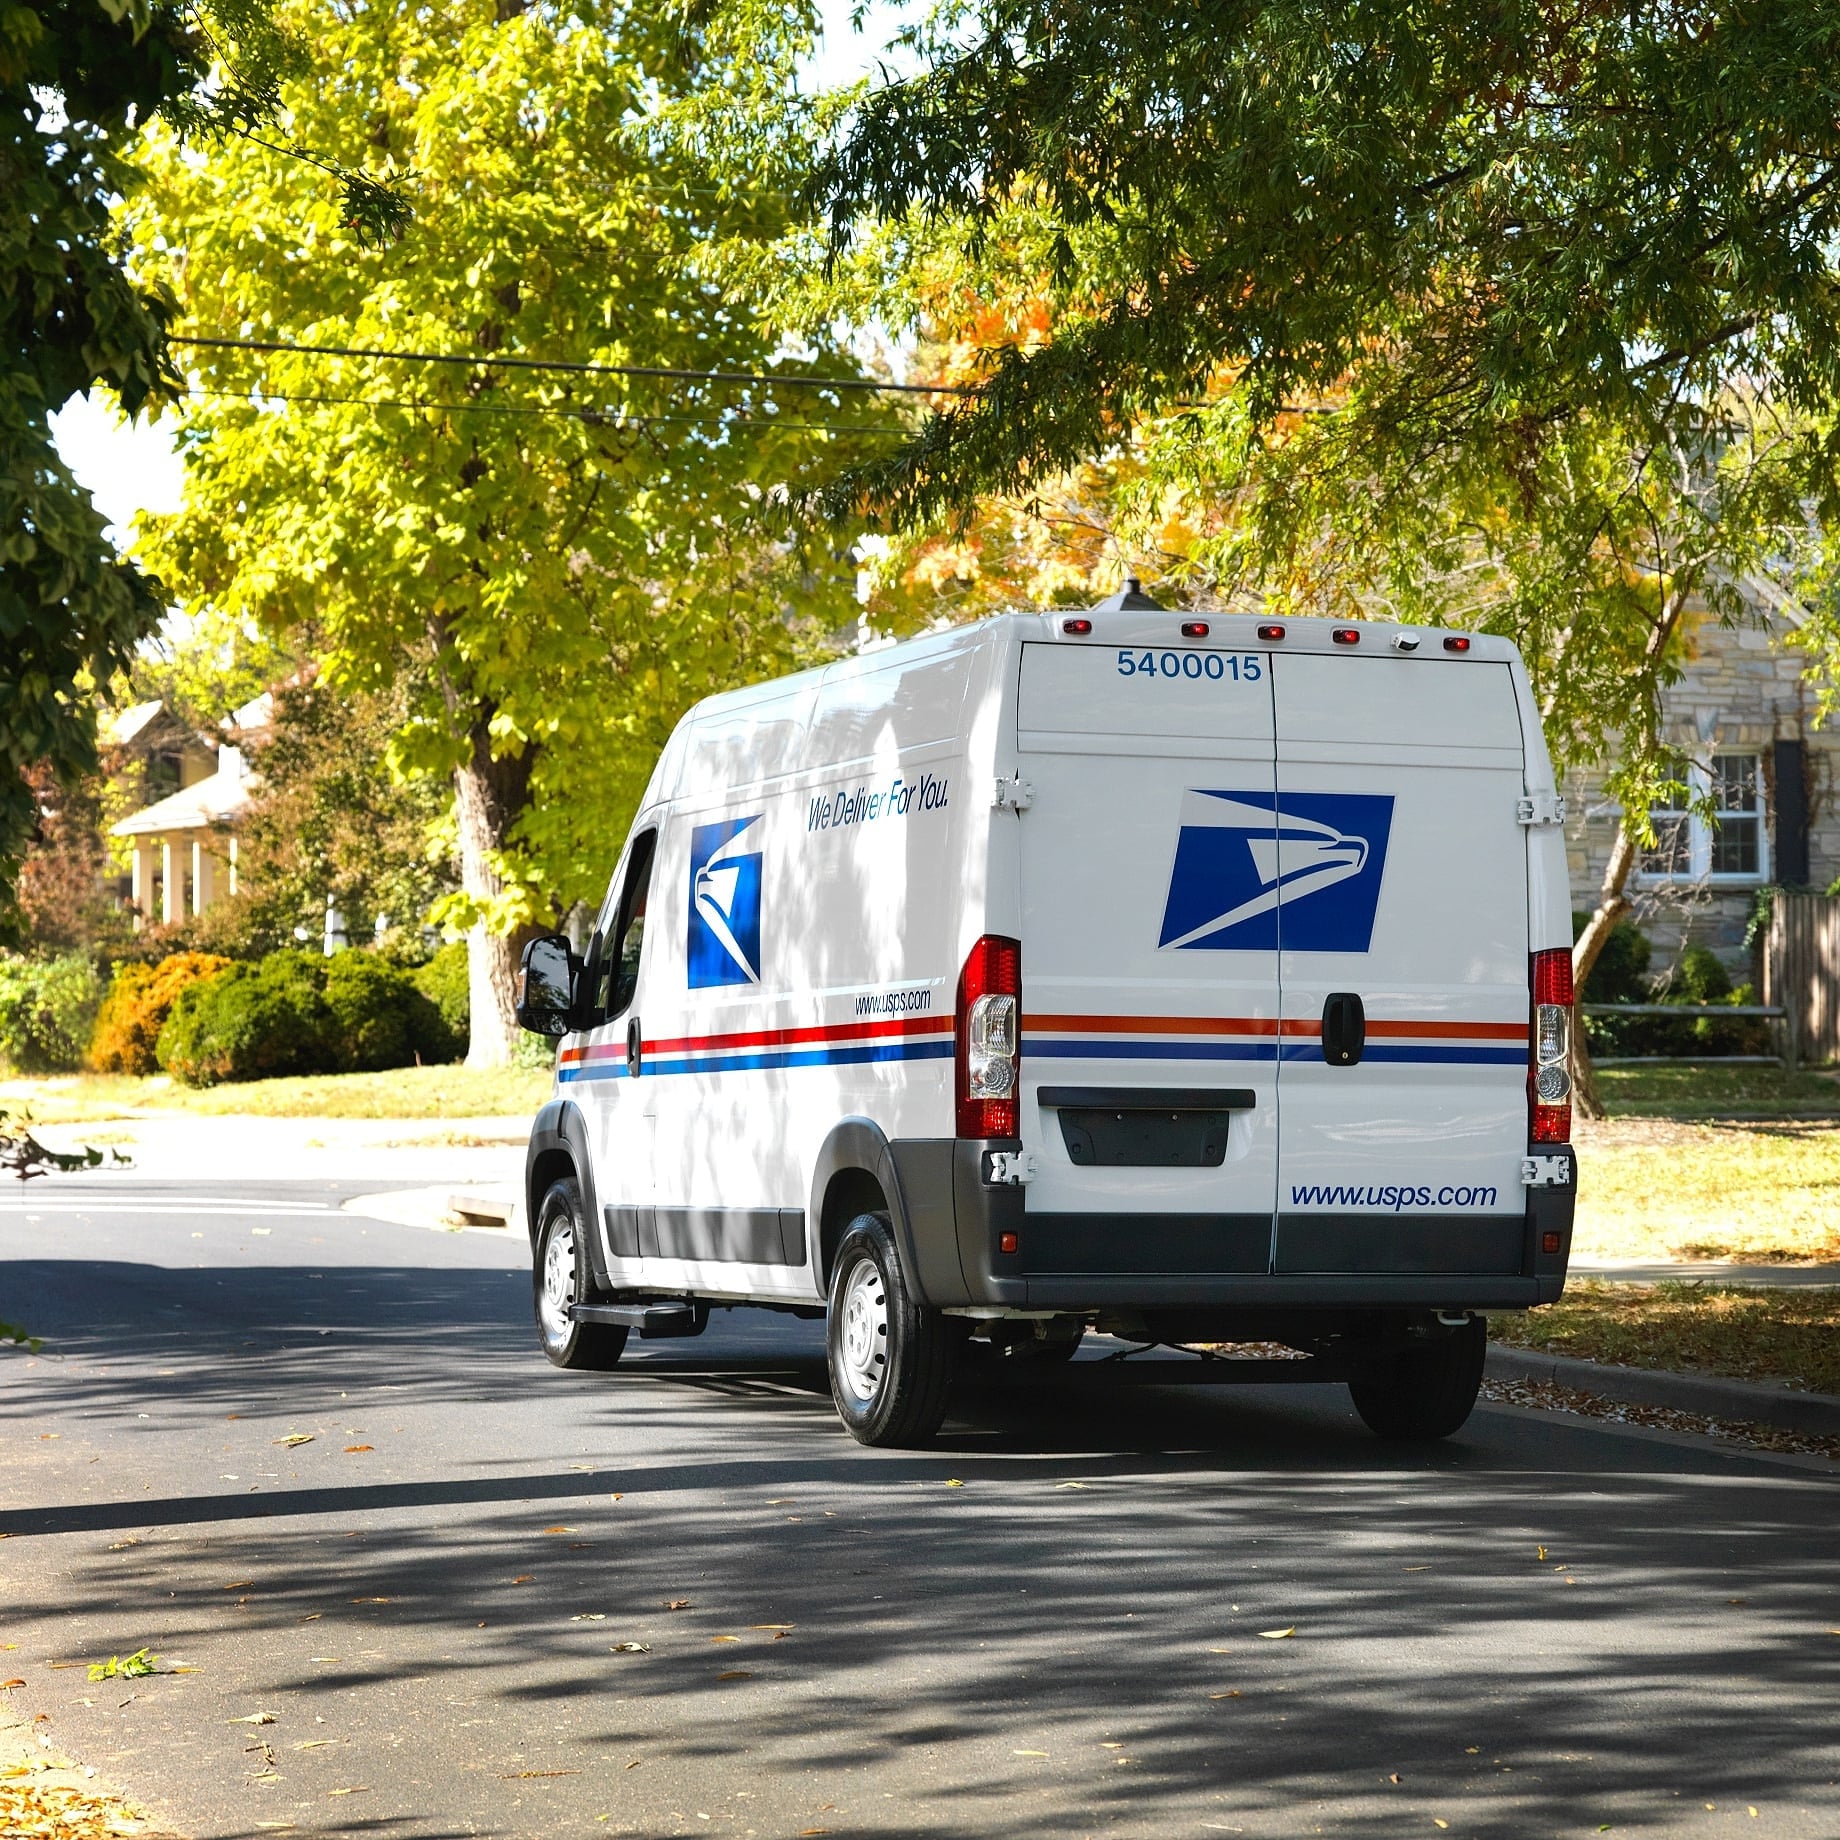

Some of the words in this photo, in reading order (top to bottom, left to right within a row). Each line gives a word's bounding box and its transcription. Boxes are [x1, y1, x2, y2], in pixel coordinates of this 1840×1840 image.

[1117, 651, 1262, 681] 5400015
[808, 795, 831, 832] We
[831, 787, 887, 827] Deliver
[888, 779, 917, 816] For
[917, 773, 949, 812] You.
[855, 989, 931, 1018] www.usps.com
[1292, 1185, 1497, 1212] www.usps.com
